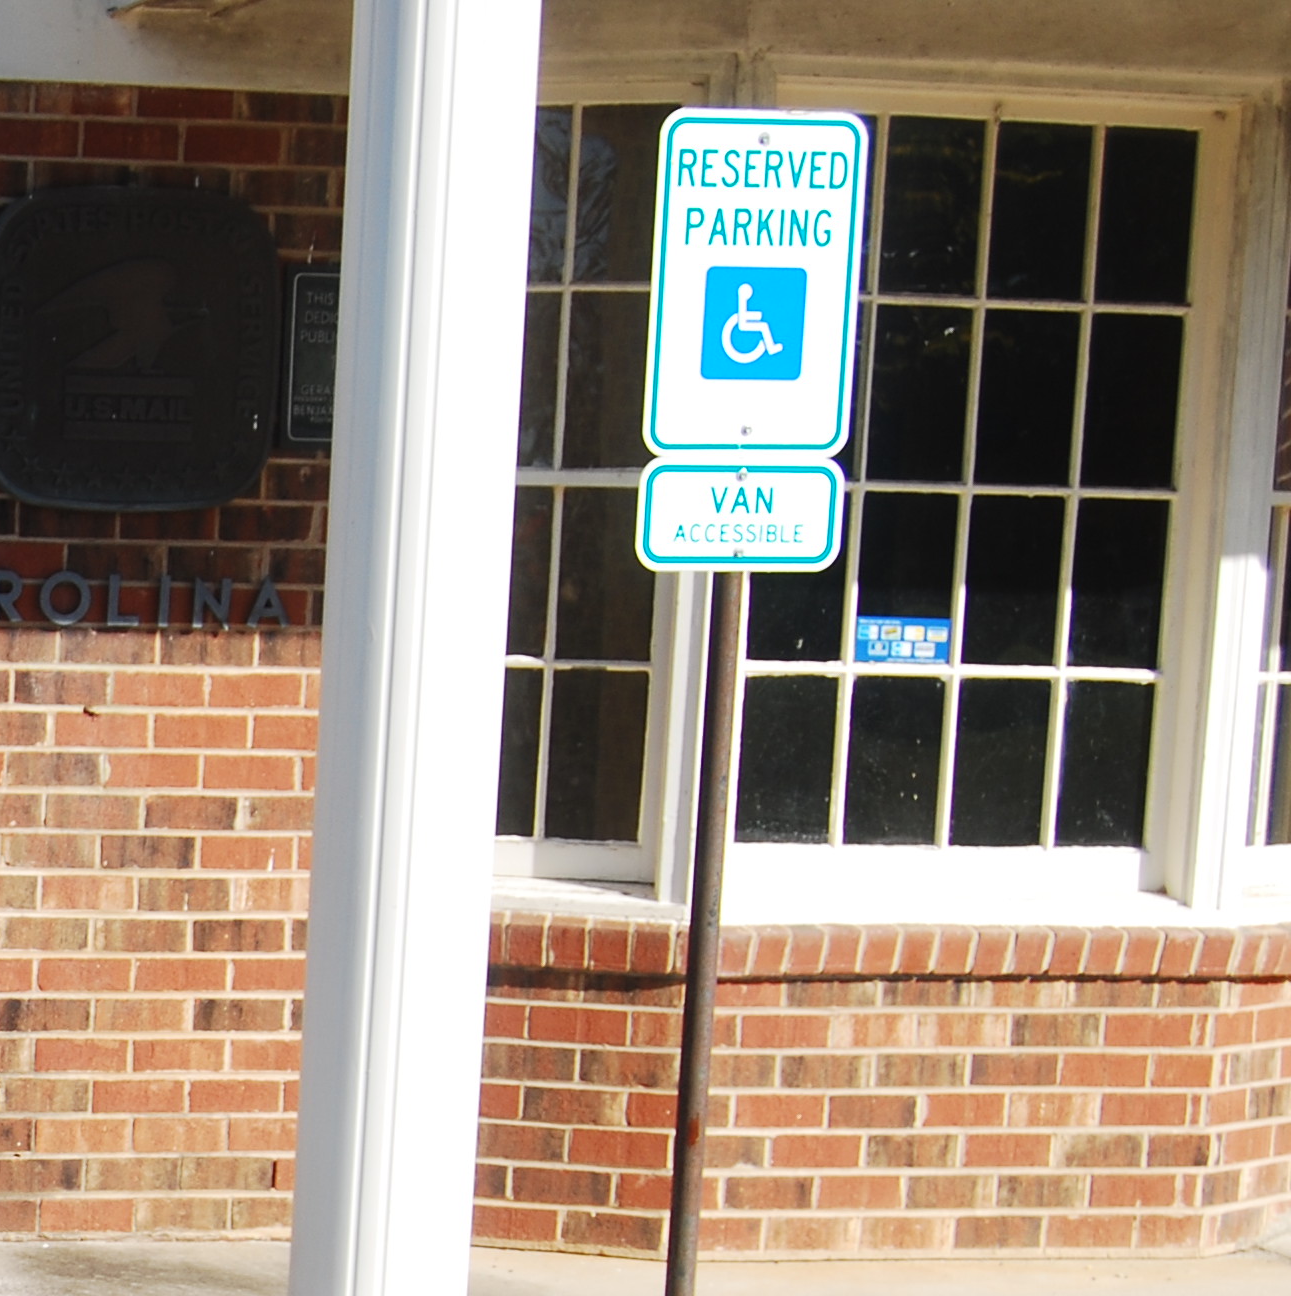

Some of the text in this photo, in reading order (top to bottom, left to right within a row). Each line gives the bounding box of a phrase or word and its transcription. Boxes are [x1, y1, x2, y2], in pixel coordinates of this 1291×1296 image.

[677, 148, 848, 190] RESERVED
[683, 207, 833, 247] PARKING
[710, 486, 774, 514] VAN
[673, 523, 805, 544] ACCESSIBLE
